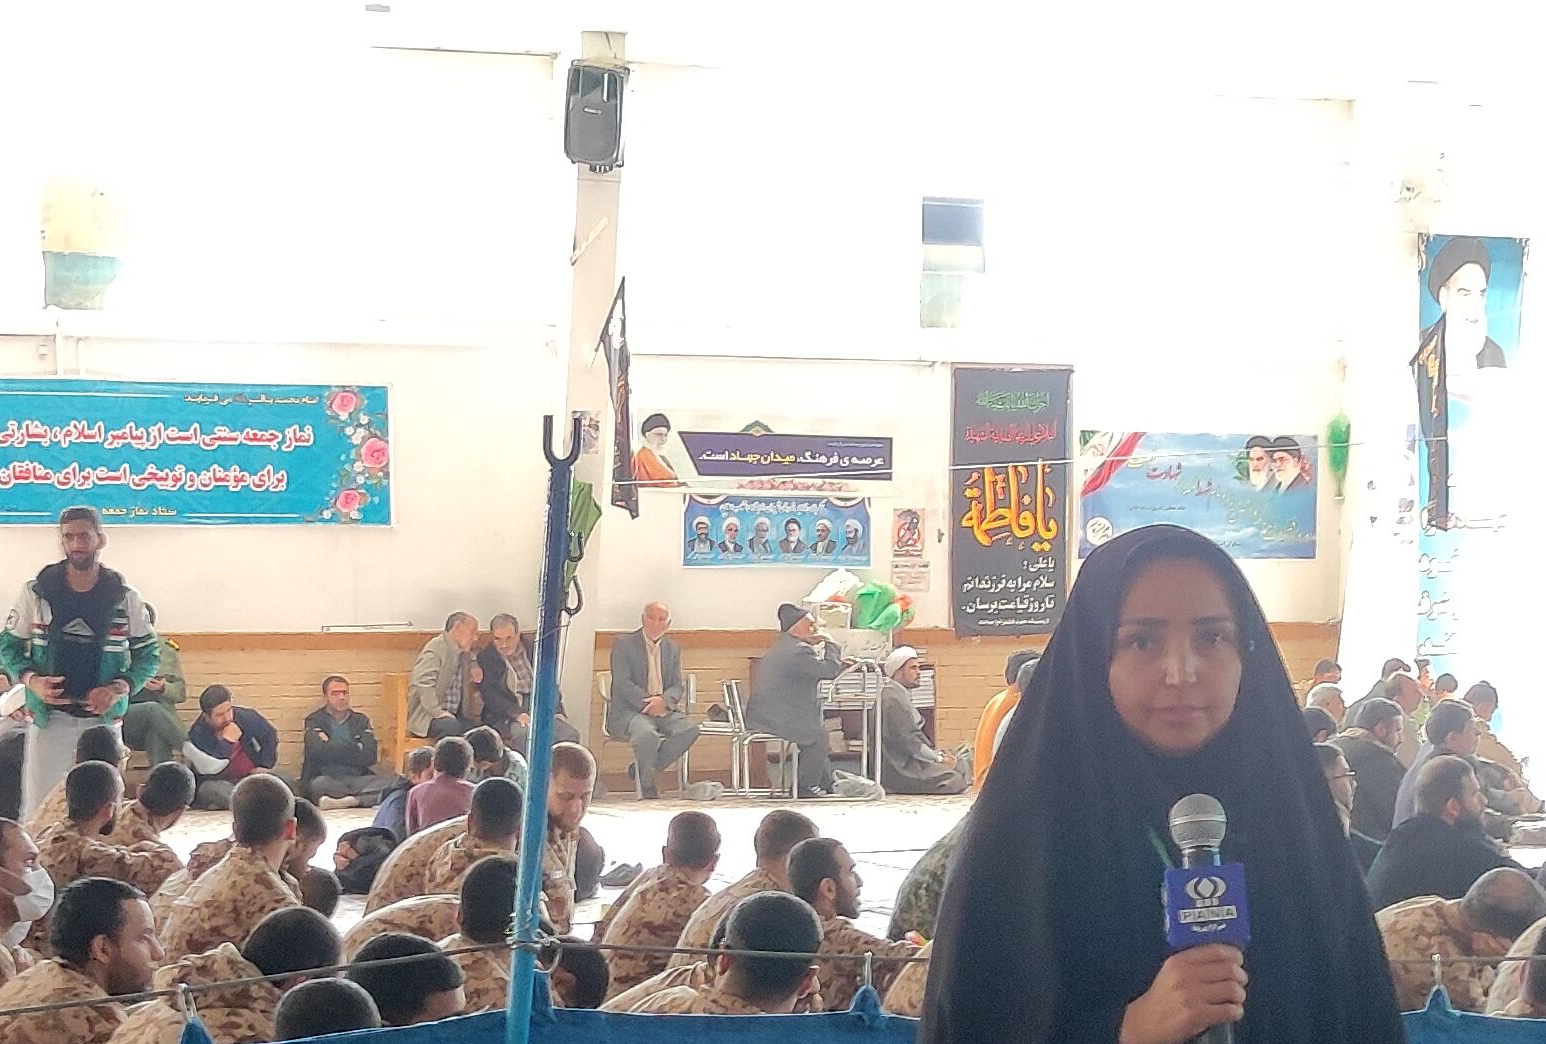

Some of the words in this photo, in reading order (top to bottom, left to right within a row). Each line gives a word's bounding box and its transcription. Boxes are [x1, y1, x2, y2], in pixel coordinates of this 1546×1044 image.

[104, 421, 148, 450] پیامبر
[146, 421, 165, 451] از
[165, 422, 200, 445] است
[201, 425, 240, 450] سنتی
[242, 428, 281, 451] جمعه
[282, 424, 314, 451] نماز
[760, 450, 796, 466] میدان
[54, 461, 94, 490] برای
[94, 461, 130, 486] است
[130, 463, 185, 492] توبیخی
[184, 468, 198, 491] و
[251, 464, 287, 492] برای
[1006, 578, 1017, 593] به
[1017, 576, 1033, 593] مرا
[1033, 575, 1056, 592] سلام
[998, 594, 1029, 614] قیامت
[1027, 598, 1046, 613] روز
[1045, 594, 1055, 609] تا
[1183, 907, 1234, 921] PANA
